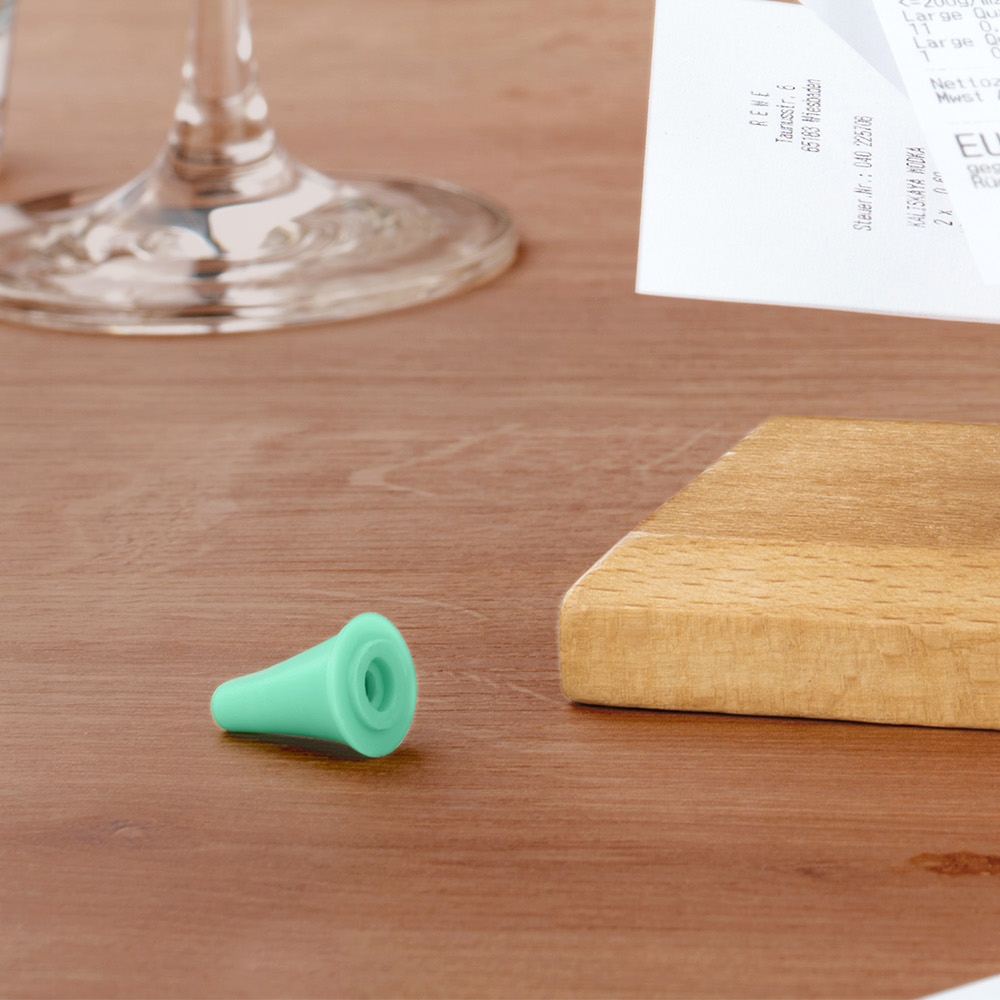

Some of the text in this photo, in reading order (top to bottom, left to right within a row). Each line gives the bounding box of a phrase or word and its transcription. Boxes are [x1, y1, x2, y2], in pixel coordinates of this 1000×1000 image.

[902, 10, 962, 23] Large
[912, 36, 975, 49] Large
[776, 84, 796, 92] 6
[801, 78, 821, 153] 65183 Wiesbaden
